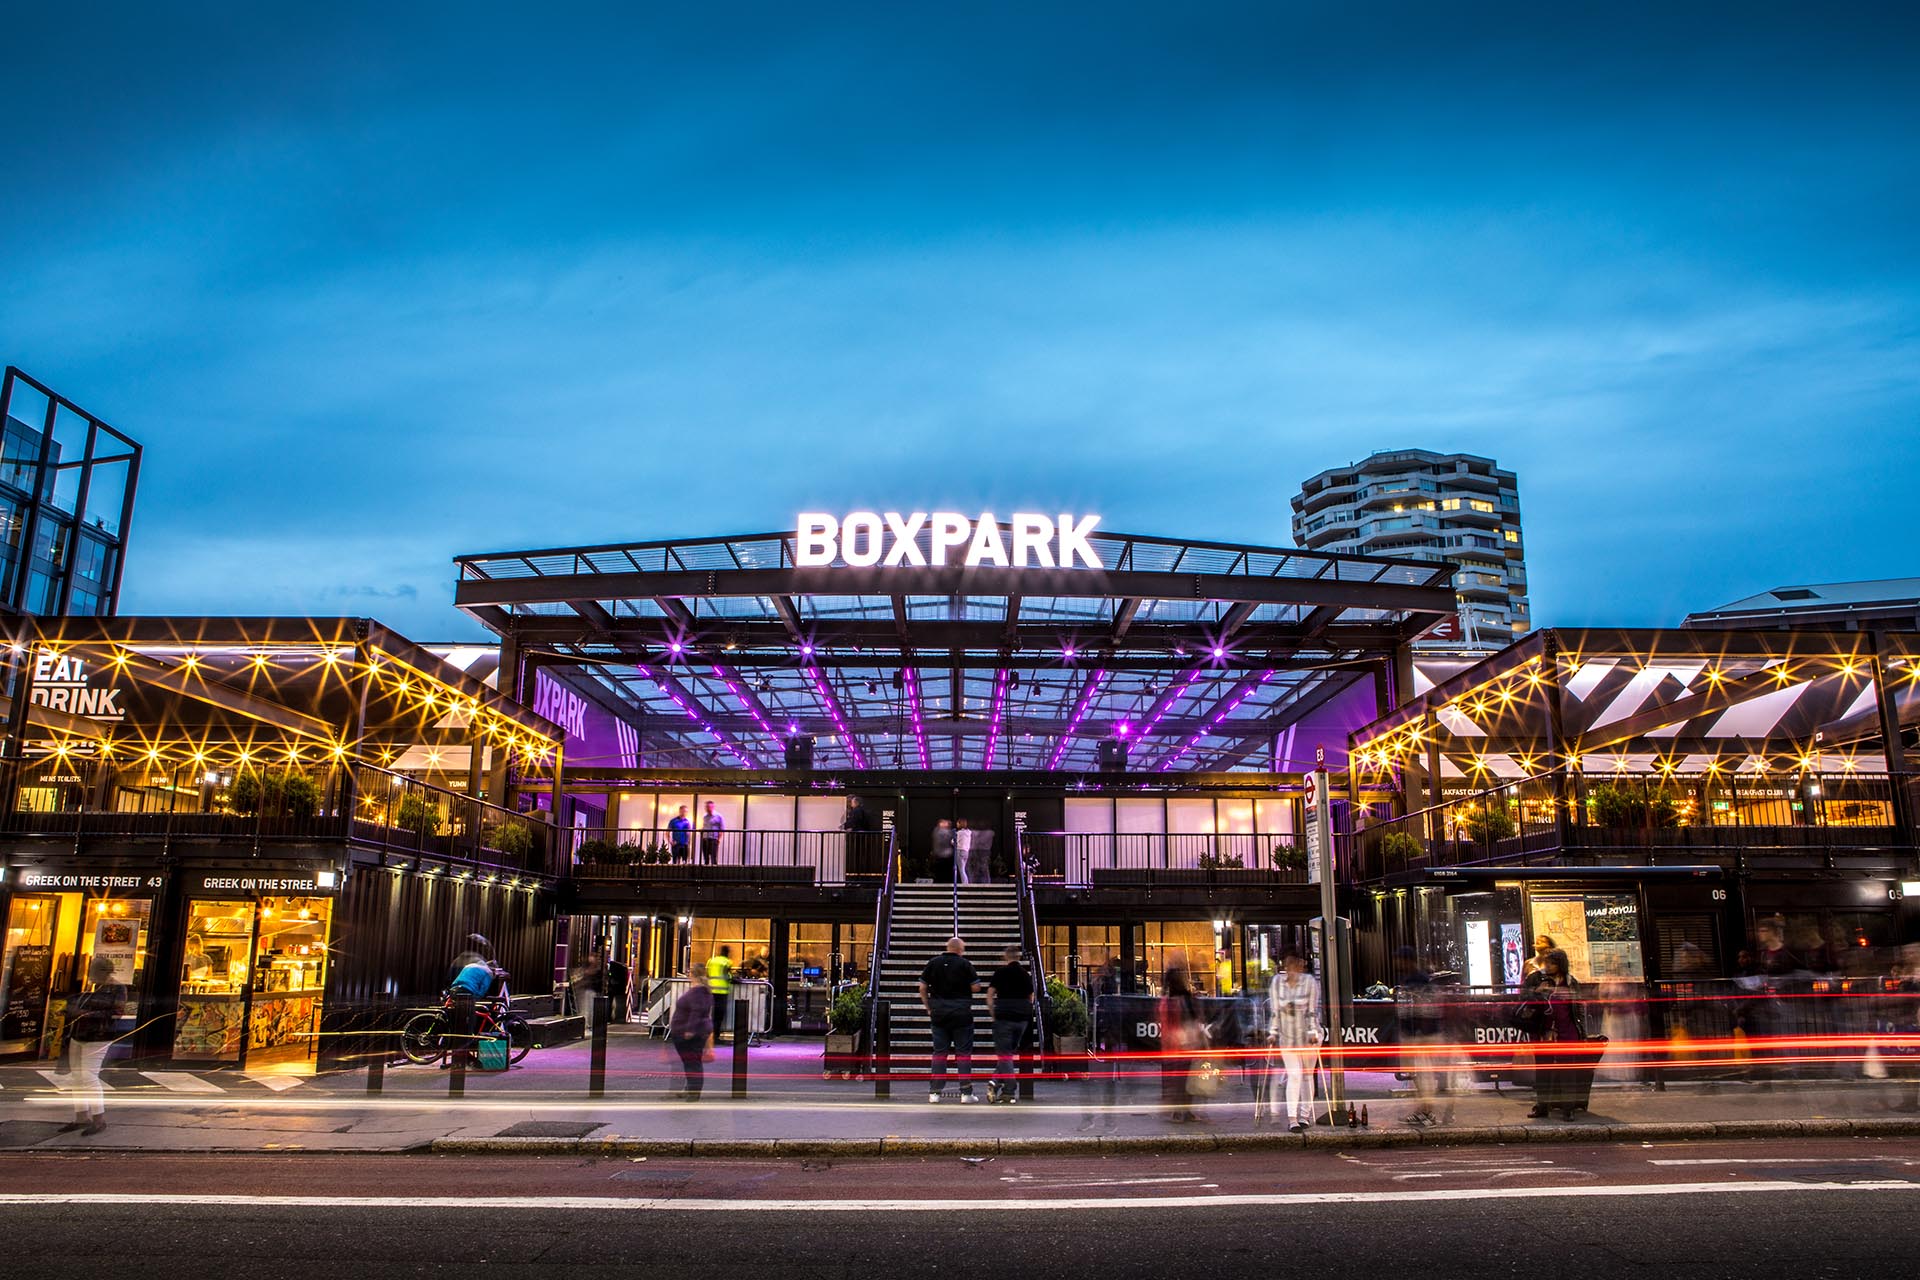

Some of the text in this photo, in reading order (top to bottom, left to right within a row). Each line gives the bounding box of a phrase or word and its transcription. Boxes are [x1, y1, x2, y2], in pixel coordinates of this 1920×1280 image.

[796, 511, 1104, 568] BOXPARK
[34, 655, 88, 681] EAT.
[31, 688, 125, 714] DRINK.
[533, 668, 587, 742] XPARK
[1316, 748, 1325, 762] E8
[25, 875, 162, 888] GREEK ON THE STREET 43
[203, 877, 239, 889] GREEK
[241, 878, 256, 889] ON
[258, 878, 278, 889] THE
[280, 879, 317, 890] STREE
[1712, 889, 1727, 900] 06
